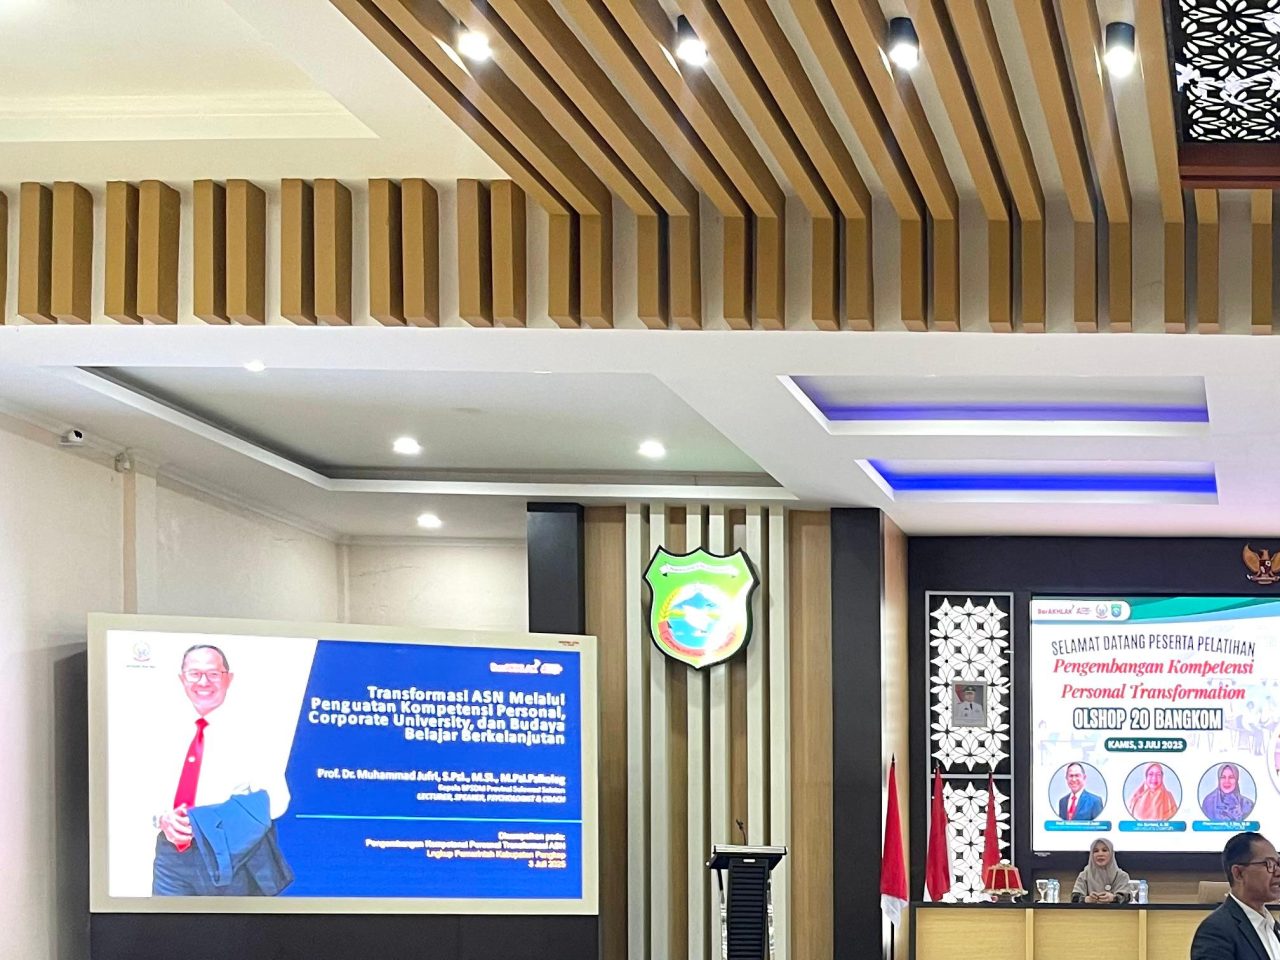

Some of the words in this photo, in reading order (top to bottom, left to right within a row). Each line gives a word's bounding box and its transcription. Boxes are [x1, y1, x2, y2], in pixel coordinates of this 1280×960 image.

[1052, 636, 1100, 656] SELAMAT
[1103, 634, 1146, 651] DATANG
[1149, 634, 1194, 651] PESERTA
[1197, 635, 1255, 657] PELATIHAN
[1053, 658, 1164, 677] Pengembangan
[1167, 658, 1255, 677] Kompetensi
[367, 686, 468, 702] Transformasi
[471, 690, 504, 703] ASN
[509, 692, 565, 706] Melalui
[1061, 683, 1126, 699] Personal
[1130, 683, 1245, 702] Transformation
[311, 697, 396, 716] Penguatan
[401, 701, 493, 720] Kompetensi
[497, 704, 566, 721] Personal,
[308, 711, 389, 727] Corporate
[393, 714, 474, 732] University,
[477, 716, 506, 730] dan
[510, 718, 565, 735] Budaya
[1073, 708, 1126, 729] OLSHOP
[1131, 708, 1150, 729] 20
[1154, 708, 1223, 730] BANGKOM
[405, 727, 458, 743] Belajar
[462, 729, 565, 746] Berkelanjutan
[1108, 742, 1138, 750] KAMIS,
[317, 768, 340, 779] Prof.
[342, 769, 355, 779] Dr.
[357, 769, 416, 781] Muhammad
[417, 770, 441, 783] Jufri,
